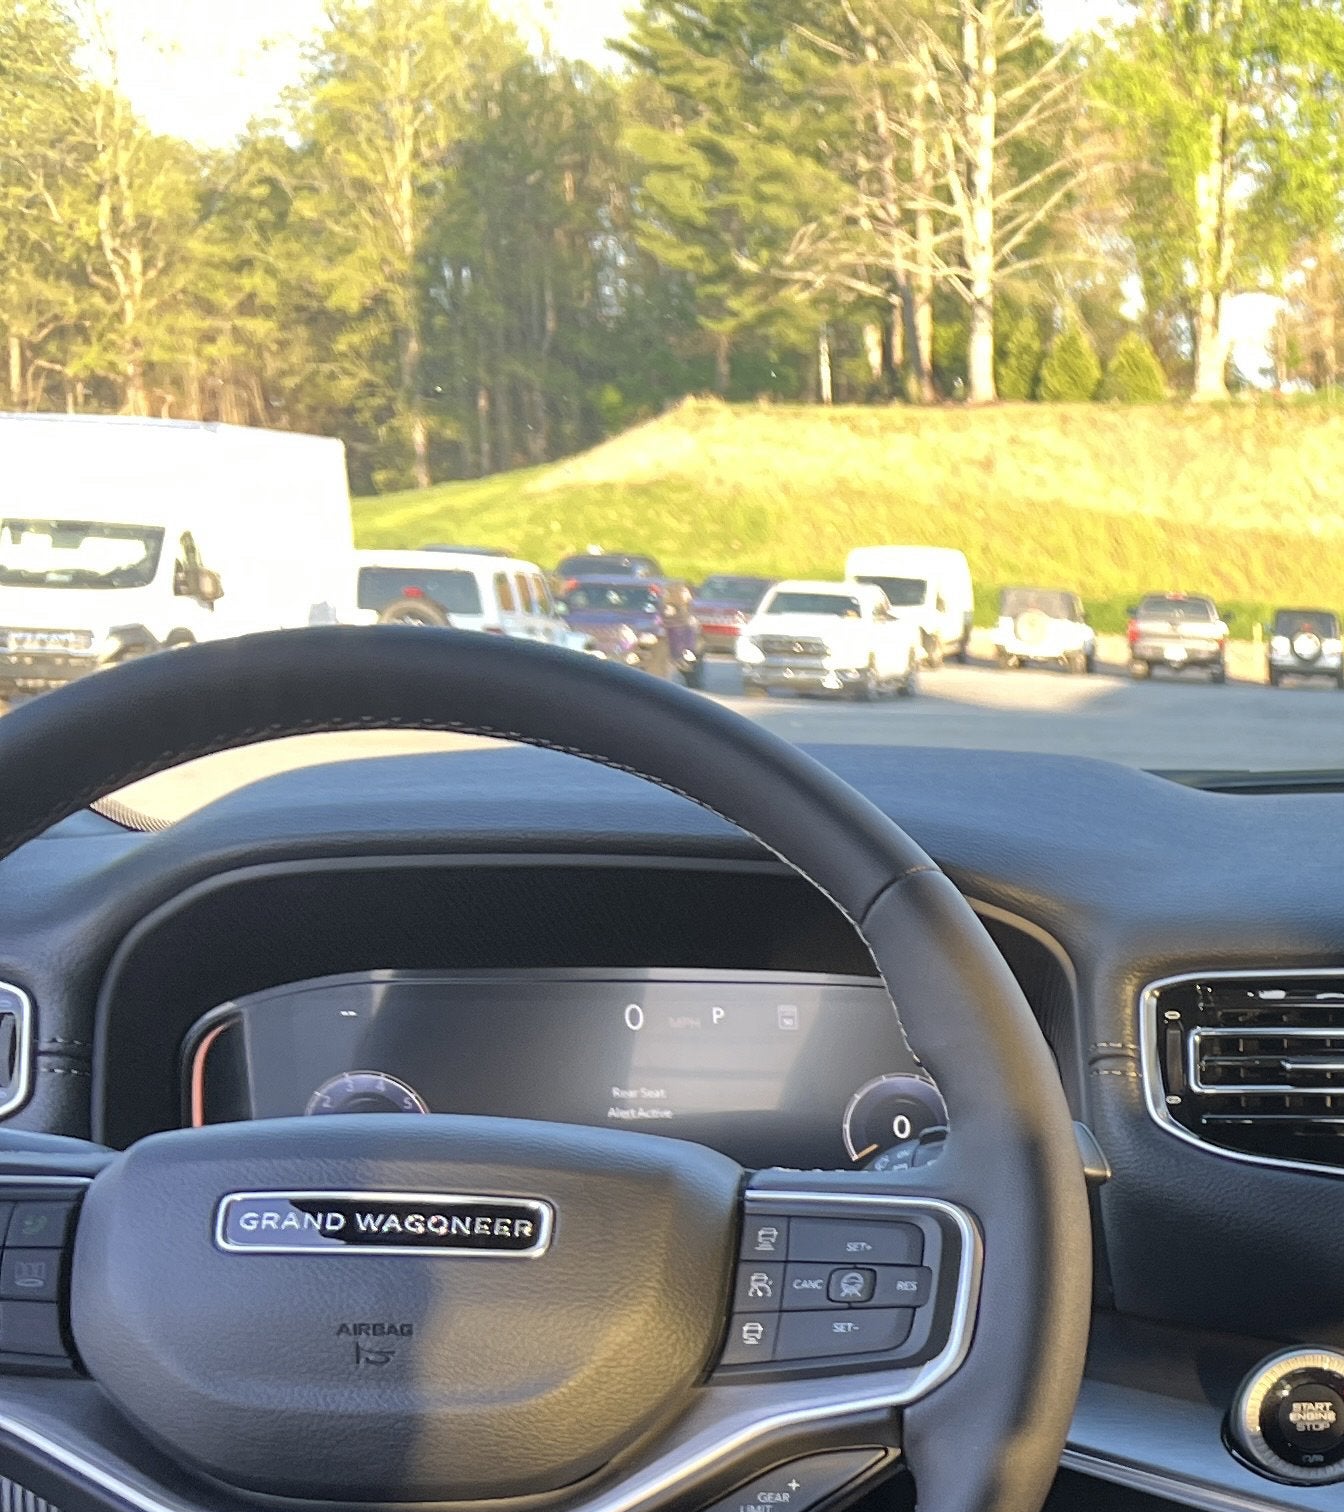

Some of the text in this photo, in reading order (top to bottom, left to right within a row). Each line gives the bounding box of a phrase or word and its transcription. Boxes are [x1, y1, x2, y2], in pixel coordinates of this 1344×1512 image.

[625, 1004, 644, 1031] 0
[712, 1007, 725, 1024] P
[892, 1115, 911, 1139] 0
[239, 1211, 533, 1237] GRAND WAGONEER
[793, 1279, 825, 1290] CANC
[896, 1281, 918, 1291] RES
[336, 1322, 414, 1337] AIRBAG
[1292, 1402, 1333, 1412] START
[1289, 1410, 1336, 1423] ENGINE
[1296, 1420, 1330, 1431] STOP
[757, 1491, 791, 1503] GEAR
